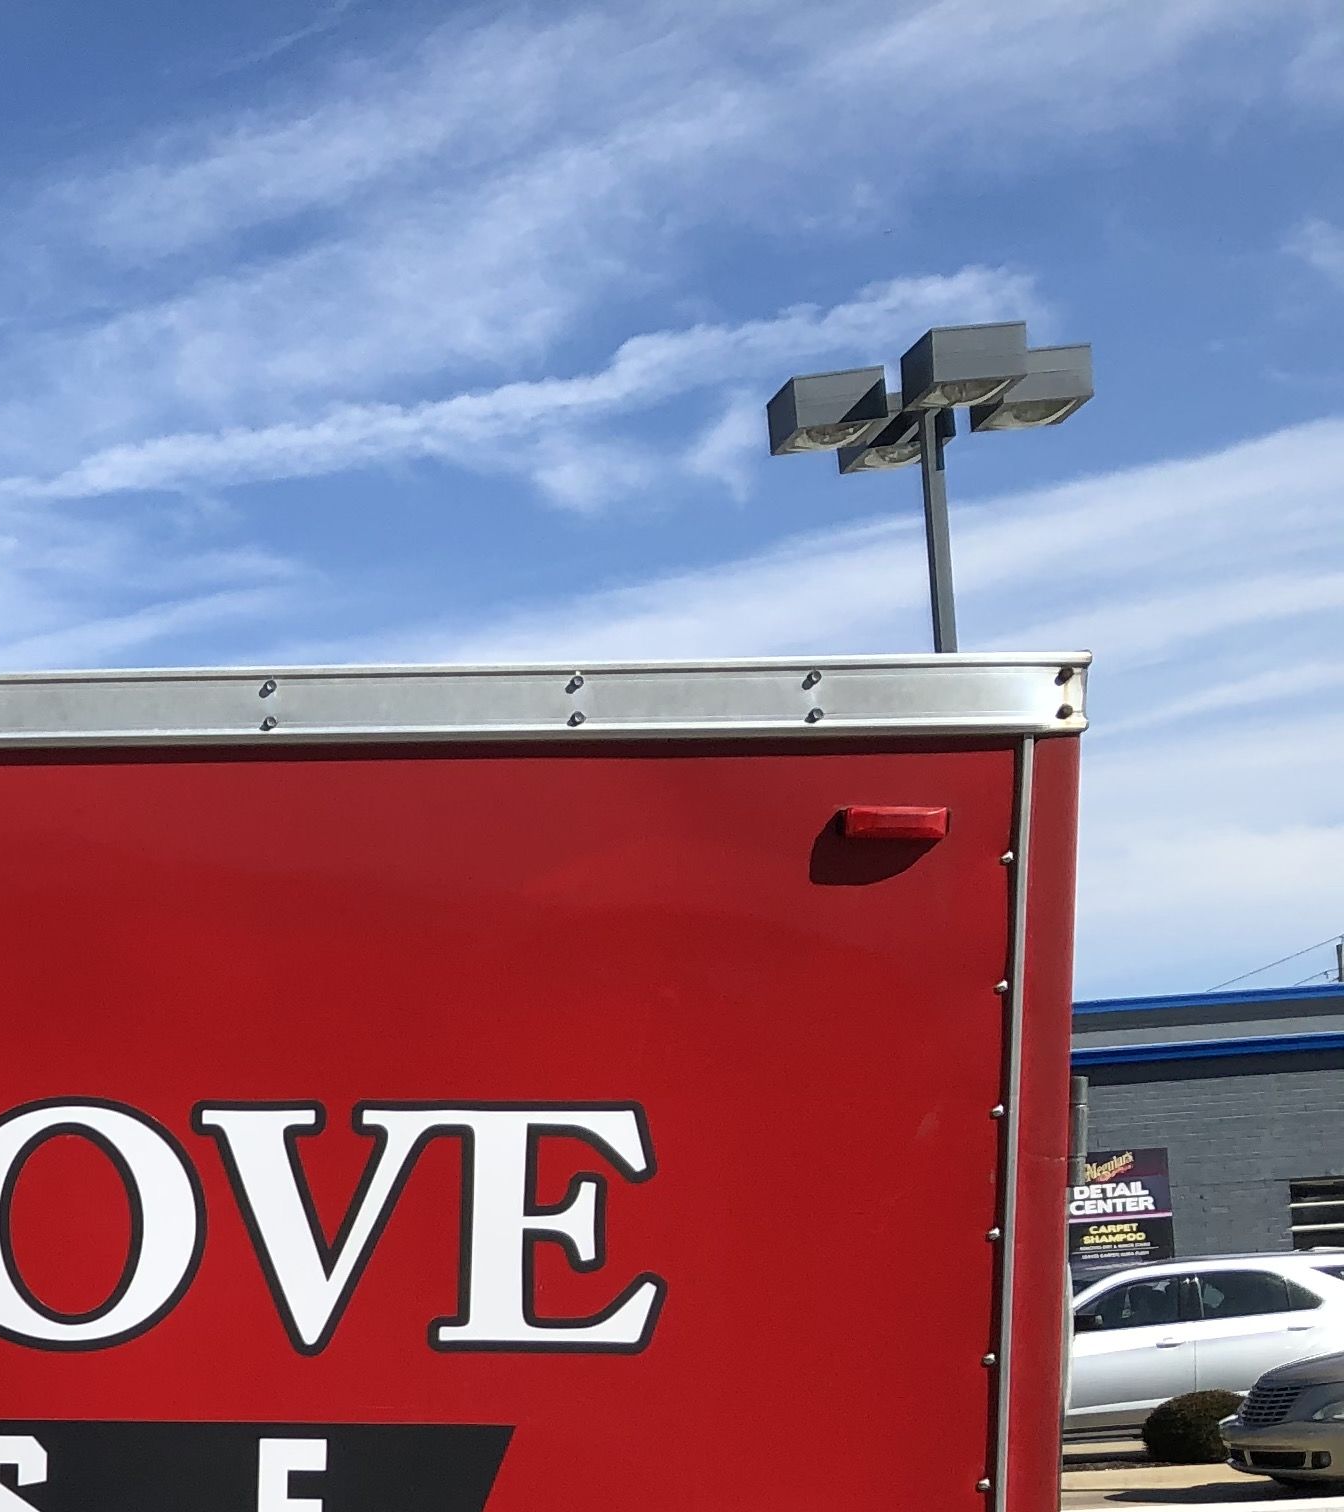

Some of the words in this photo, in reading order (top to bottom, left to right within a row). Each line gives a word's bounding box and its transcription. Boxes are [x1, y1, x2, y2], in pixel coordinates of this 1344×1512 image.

[1073, 1181, 1149, 1200] DETAIL
[1069, 1196, 1155, 1215] CENTER
[1089, 1223, 1138, 1234] CARPET
[1082, 1232, 1146, 1244] SHAMPOO
